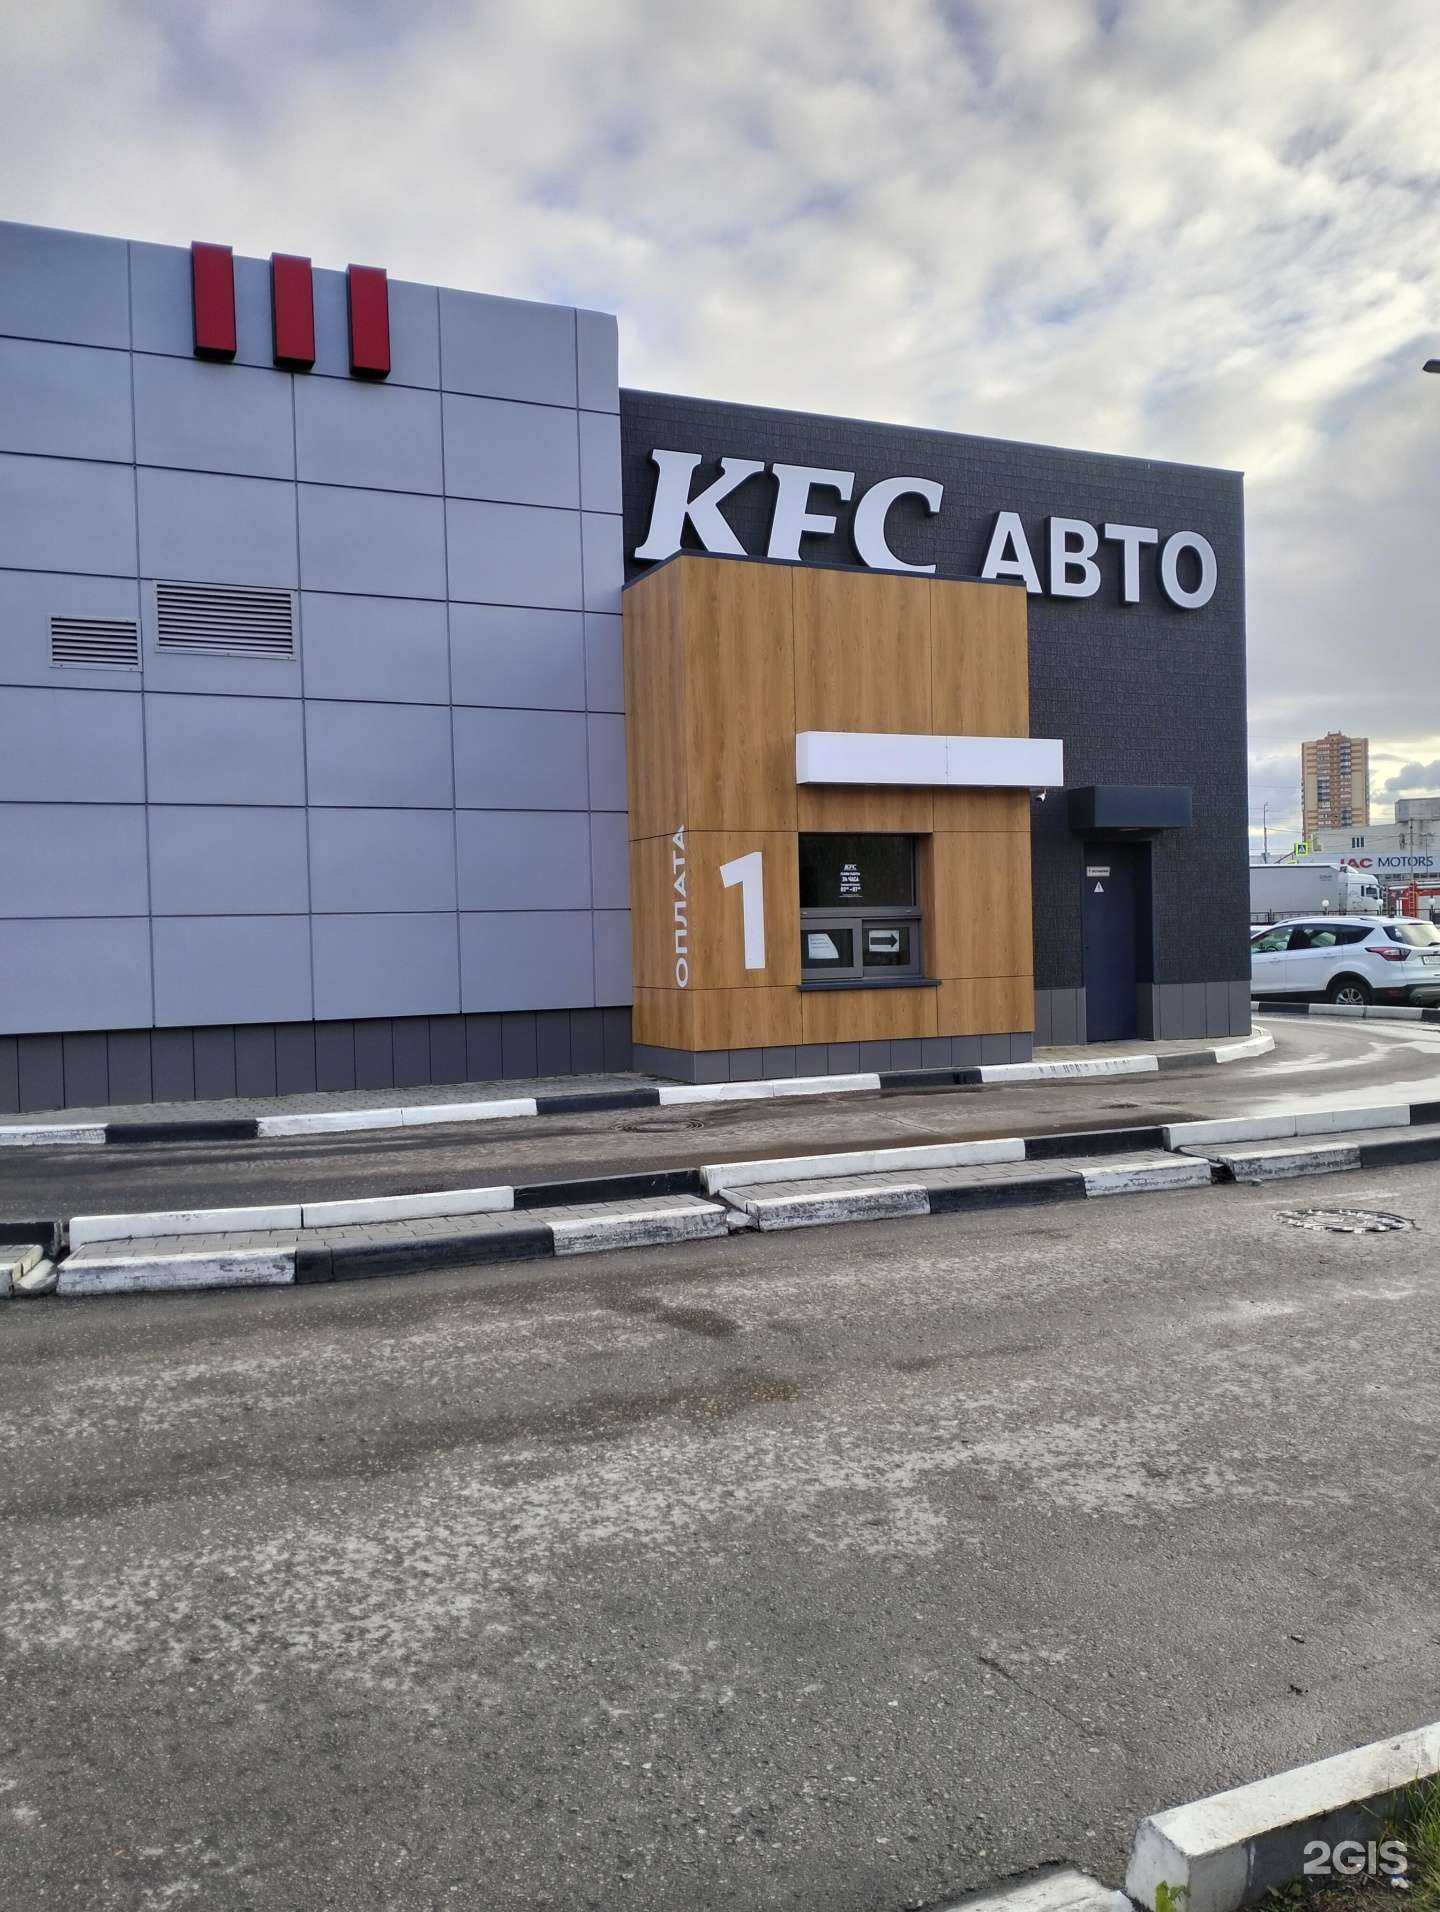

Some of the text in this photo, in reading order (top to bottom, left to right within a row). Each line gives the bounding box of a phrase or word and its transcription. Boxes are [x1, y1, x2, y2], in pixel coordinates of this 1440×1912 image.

[634, 448, 945, 574] KFC
[980, 510, 1218, 610] АВТО
[672, 824, 689, 988] ОПЛАТА
[720, 852, 766, 970] 1
[1378, 856, 1433, 868] MOTORS
